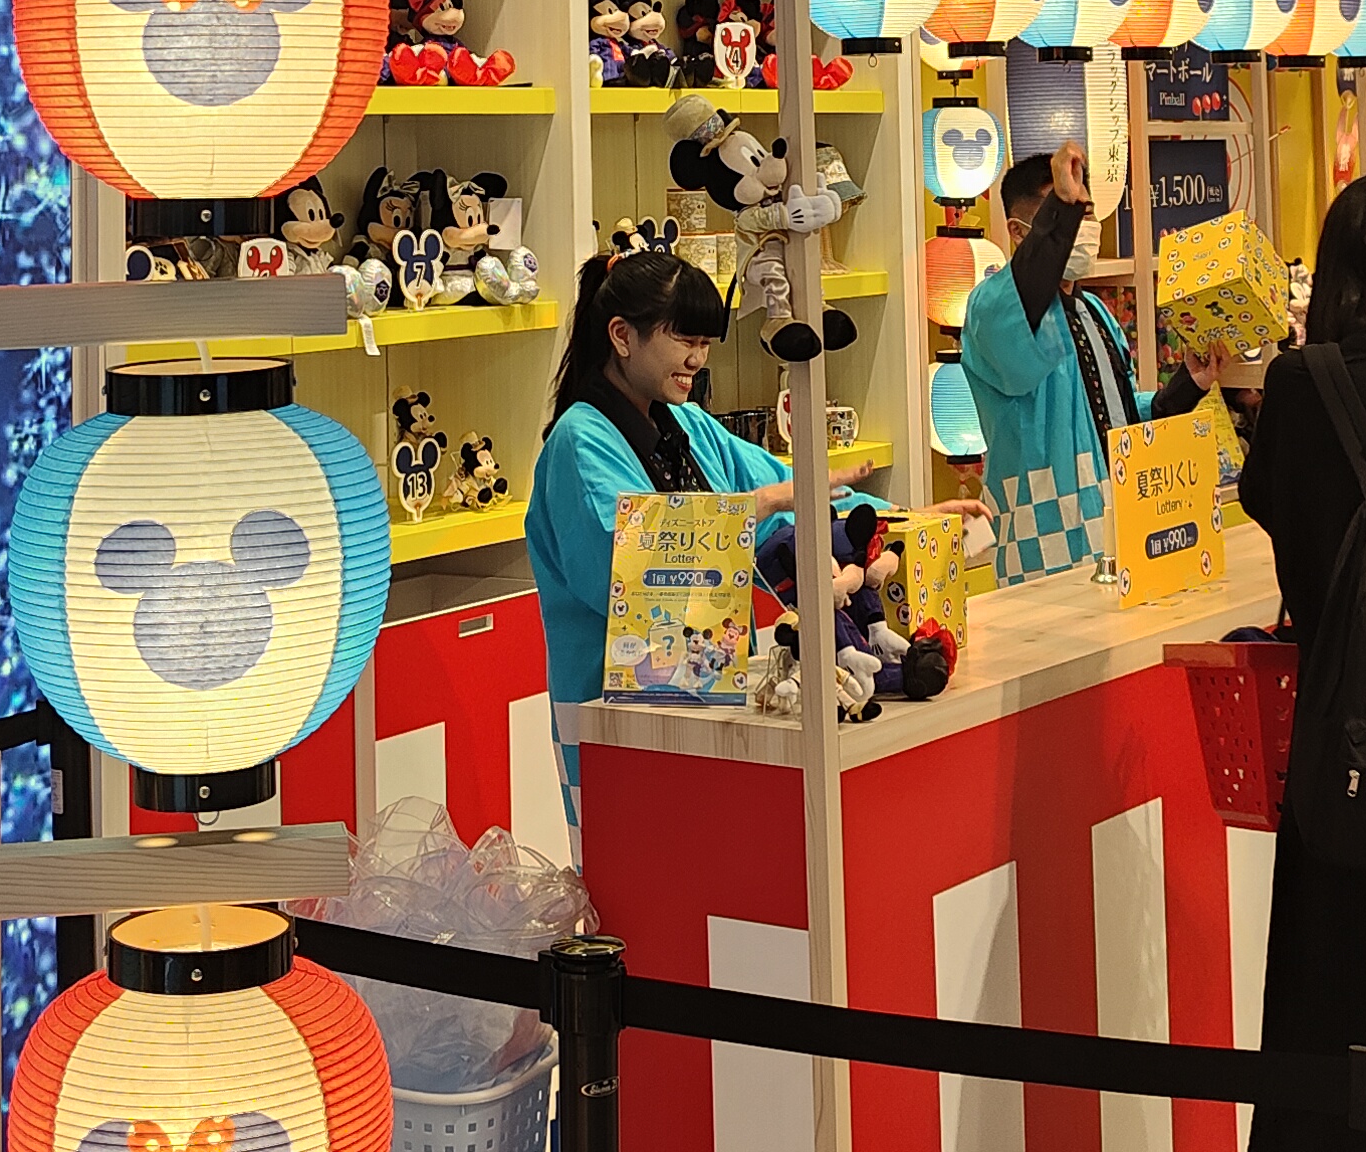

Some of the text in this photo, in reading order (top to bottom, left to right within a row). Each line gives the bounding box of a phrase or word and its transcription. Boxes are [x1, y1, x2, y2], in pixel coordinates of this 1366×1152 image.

[732, 49, 739, 67] 4
[1144, 58, 1213, 84] マートボール
[1159, 92, 1186, 106] Pinball
[1104, 45, 1121, 183] ラッグシップ東京
[1150, 173, 1204, 209] ¥1,500
[414, 264, 423, 288] 7
[407, 472, 427, 500] 13
[1136, 459, 1199, 501] 夏祭りくじ
[1156, 499, 1183, 516] Lottery
[660, 519, 715, 528] ディズニーストア
[637, 531, 731, 552] 夏祭りくじ
[1163, 527, 1187, 553] ¥990
[664, 553, 703, 564] Lottery
[669, 572, 704, 585] ¥990
